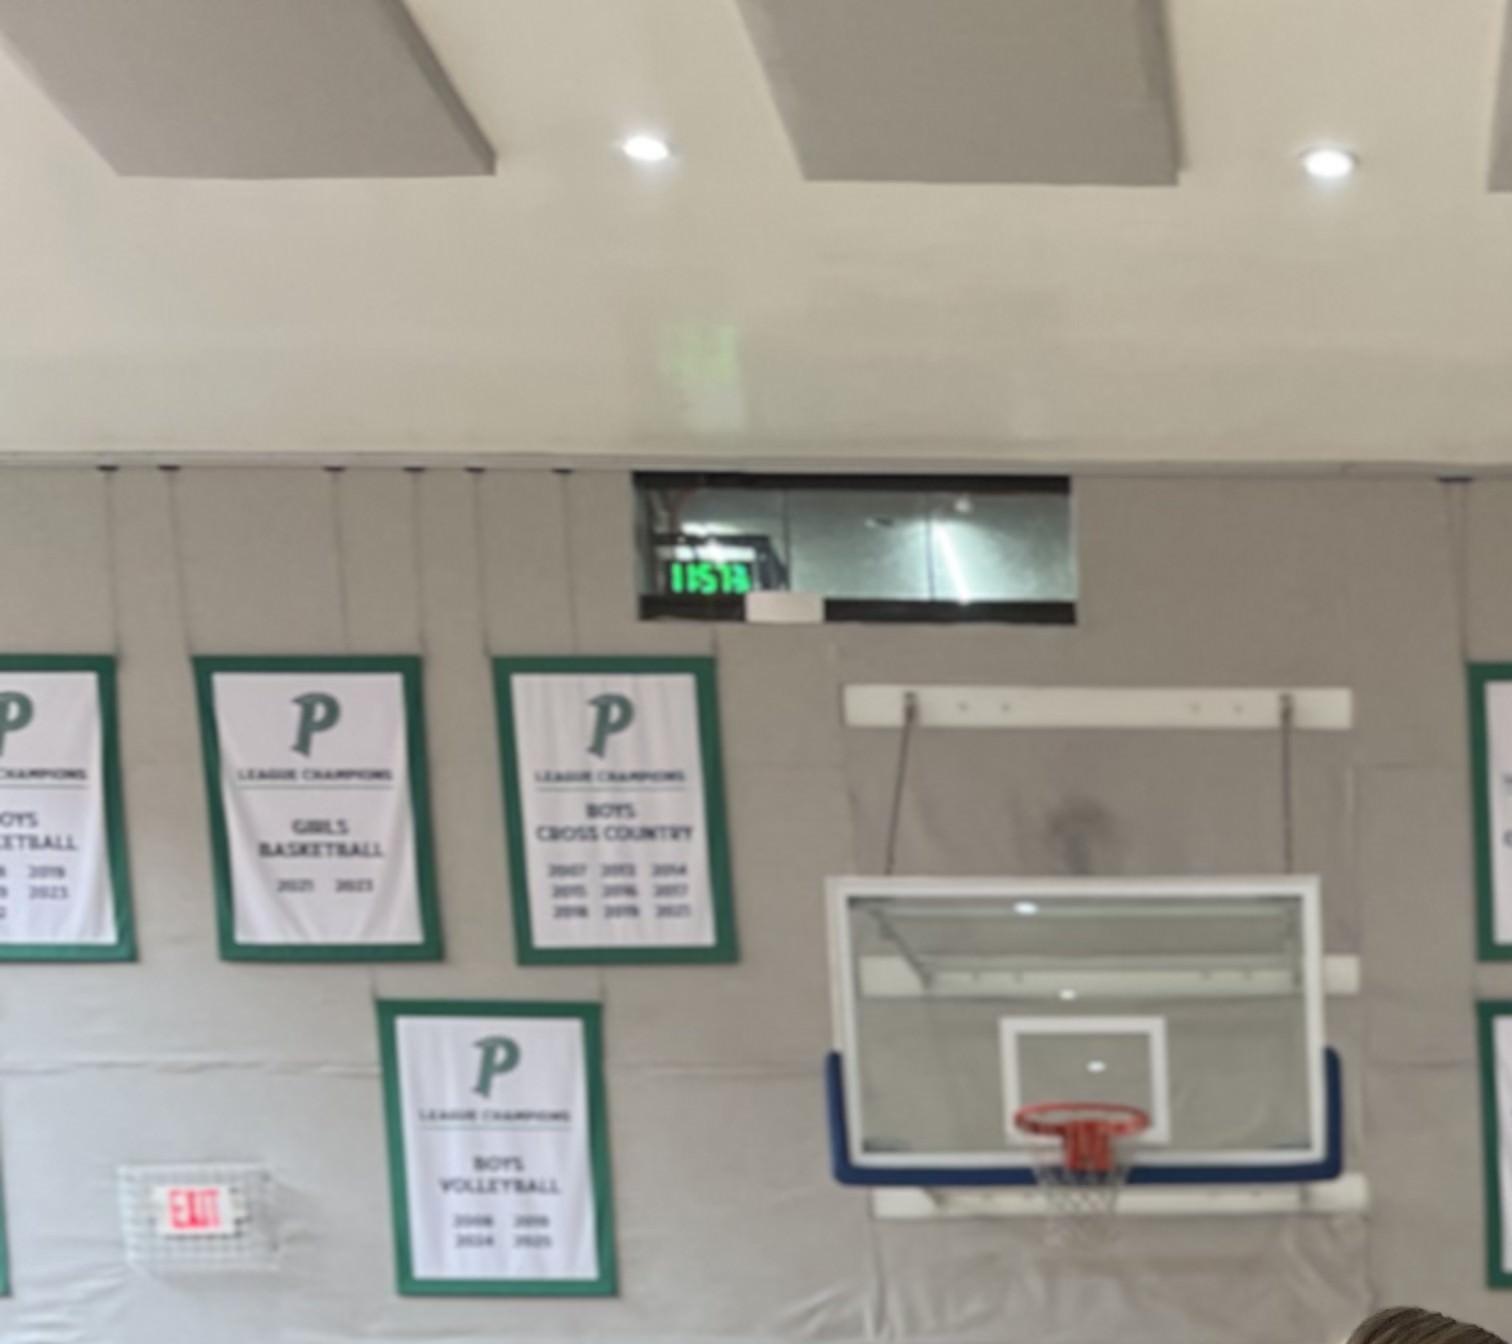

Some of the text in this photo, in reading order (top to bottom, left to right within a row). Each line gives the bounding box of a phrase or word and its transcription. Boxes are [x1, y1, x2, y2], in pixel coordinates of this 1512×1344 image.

[290, 690, 341, 758] P
[586, 692, 635, 759] P
[238, 769, 393, 780] LEAGUE CHAMPIONS
[535, 771, 686, 782] LEAGUE CHAMPIONS
[586, 803, 636, 819] BOYS
[0, 812, 38, 828] OYS
[291, 819, 349, 835] GIRLS
[536, 826, 693, 841] CROSS COUNTRY
[259, 842, 384, 857] BASKETBALL
[473, 1035, 522, 1099] P
[473, 1156, 524, 1172] BOYS
[440, 1179, 562, 1194] VOLLEYBALL
